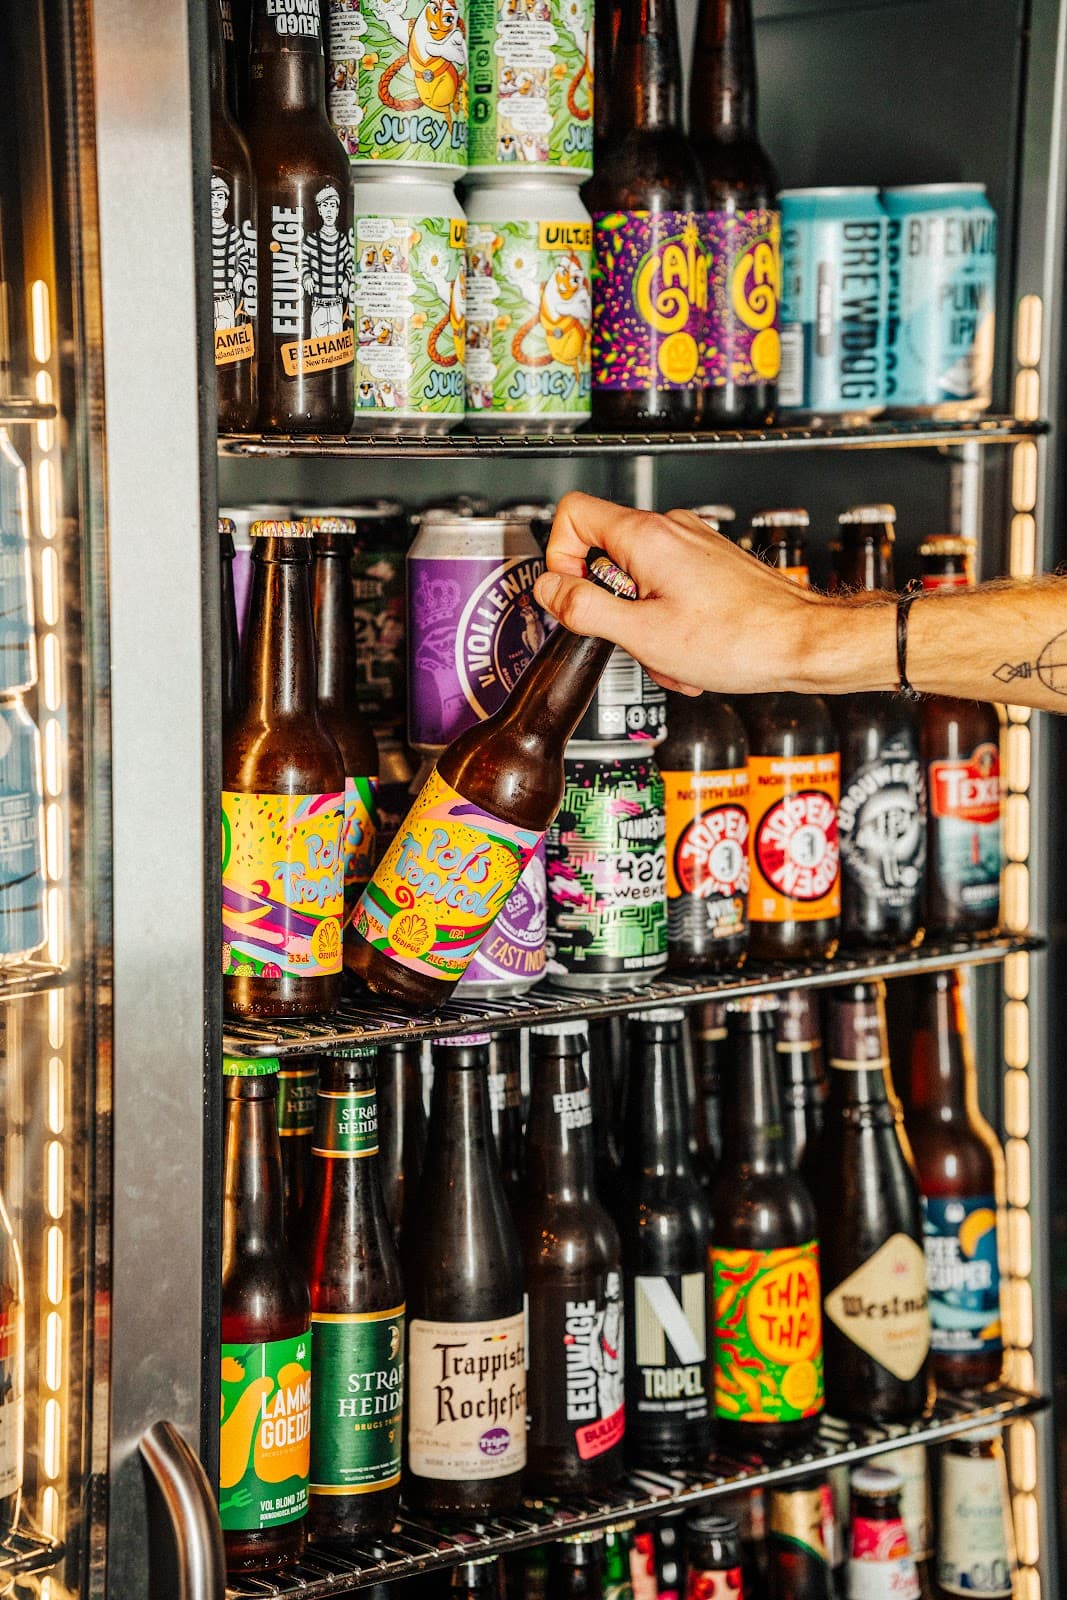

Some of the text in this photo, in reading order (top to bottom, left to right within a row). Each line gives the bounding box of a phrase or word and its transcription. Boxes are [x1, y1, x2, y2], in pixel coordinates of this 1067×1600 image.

[374, 113, 448, 150] JUICY
[545, 226, 592, 246] UILTJE
[269, 205, 304, 334] EEUWIGE
[840, 221, 881, 400] BREWDOG
[289, 335, 353, 361] BELHAMEL
[508, 370, 577, 401] JUICY
[681, 809, 748, 866] JOPEN
[761, 795, 836, 850] JOPEN
[391, 933, 422, 954] OEDIPUS
[449, 928, 466, 939] IPA
[486, 936, 525, 970] EAST
[762, 1271, 810, 1308] THA
[634, 1272, 707, 1366] N
[760, 1311, 812, 1349] THA
[563, 1299, 598, 1421] EEUWIGE
[642, 1366, 705, 1399] TRIPEL
[353, 1421, 383, 1432] BRUGS
[260, 1500, 275, 1512] VOL
[275, 1494, 296, 1510] BLOND
